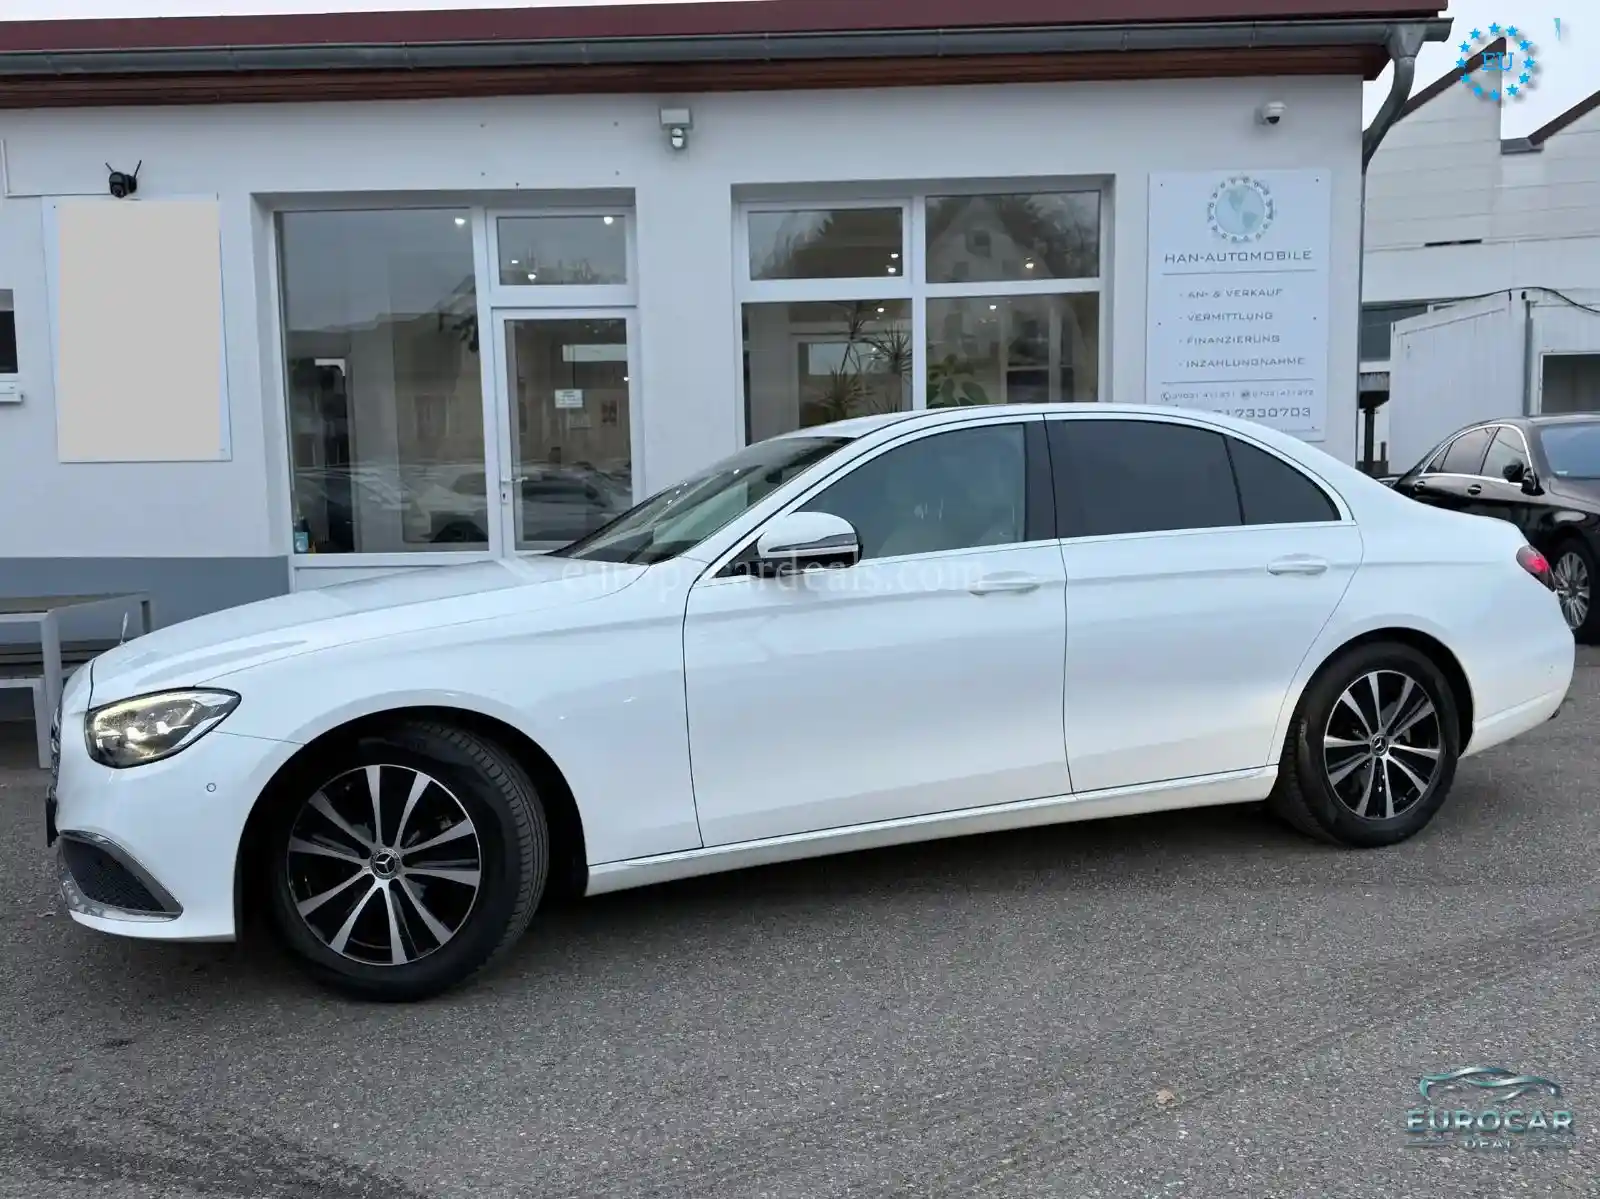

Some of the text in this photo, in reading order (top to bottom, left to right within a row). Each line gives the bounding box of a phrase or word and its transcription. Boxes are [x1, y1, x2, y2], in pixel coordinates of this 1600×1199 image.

[1164, 250, 1313, 264] HAN-AUTOMOBILE
[1225, 288, 1283, 298] VERKAUF
[1187, 311, 1274, 322] VERMITTLUNG
[1186, 334, 1281, 345] FINANZIERUNG
[1186, 357, 1307, 369] INZAHLUNGNAHME
